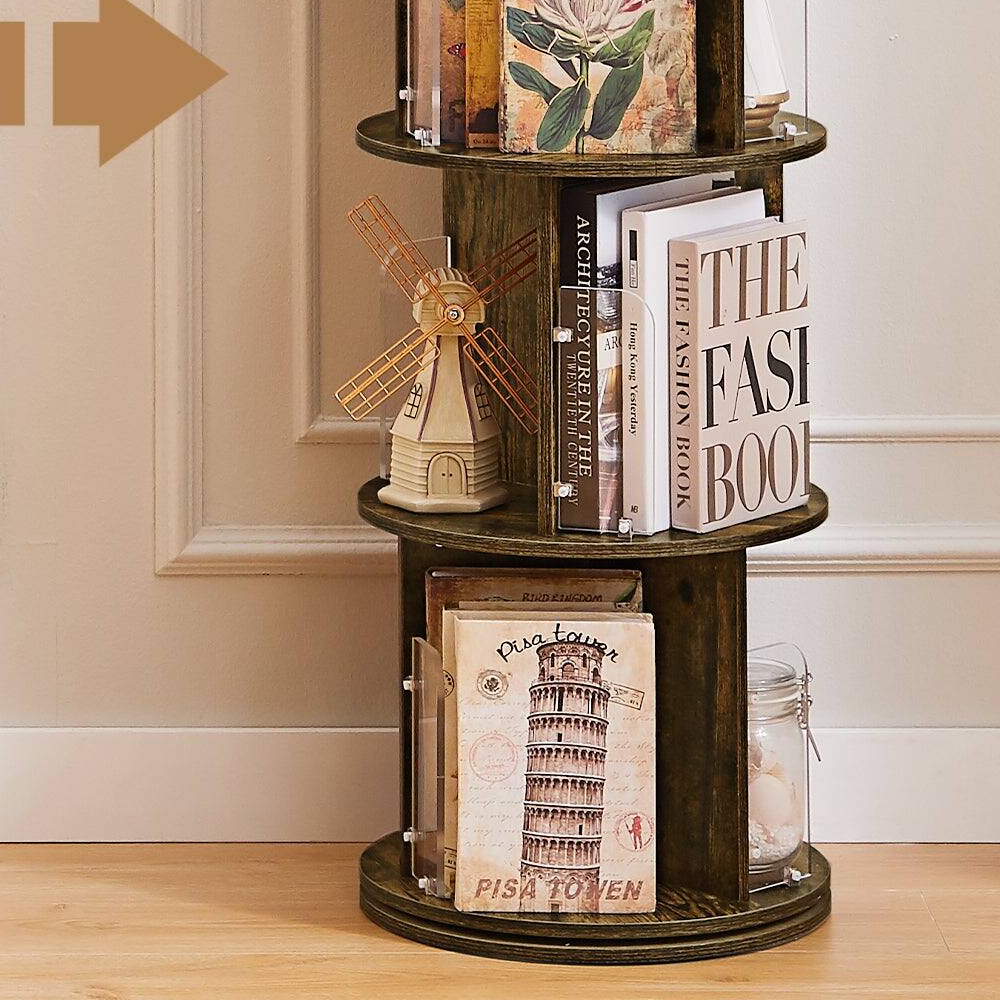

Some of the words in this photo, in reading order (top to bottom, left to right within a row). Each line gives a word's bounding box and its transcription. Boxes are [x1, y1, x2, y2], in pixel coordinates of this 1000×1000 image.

[576, 215, 592, 395] ARCHITECYURE
[675, 257, 690, 312] THE
[701, 232, 808, 331] THE
[629, 322, 638, 350] Hong
[629, 353, 638, 382] Kong
[675, 320, 691, 426] FASHION
[566, 353, 578, 436] TWENTIETH
[578, 401, 592, 425] IN
[629, 385, 639, 437] Yesterday
[579, 431, 592, 478] THE
[676, 439, 691, 510] BOOK
[496, 634, 547, 663] Pisa
[552, 623, 619, 664] tower
[474, 878, 536, 900] PISA
